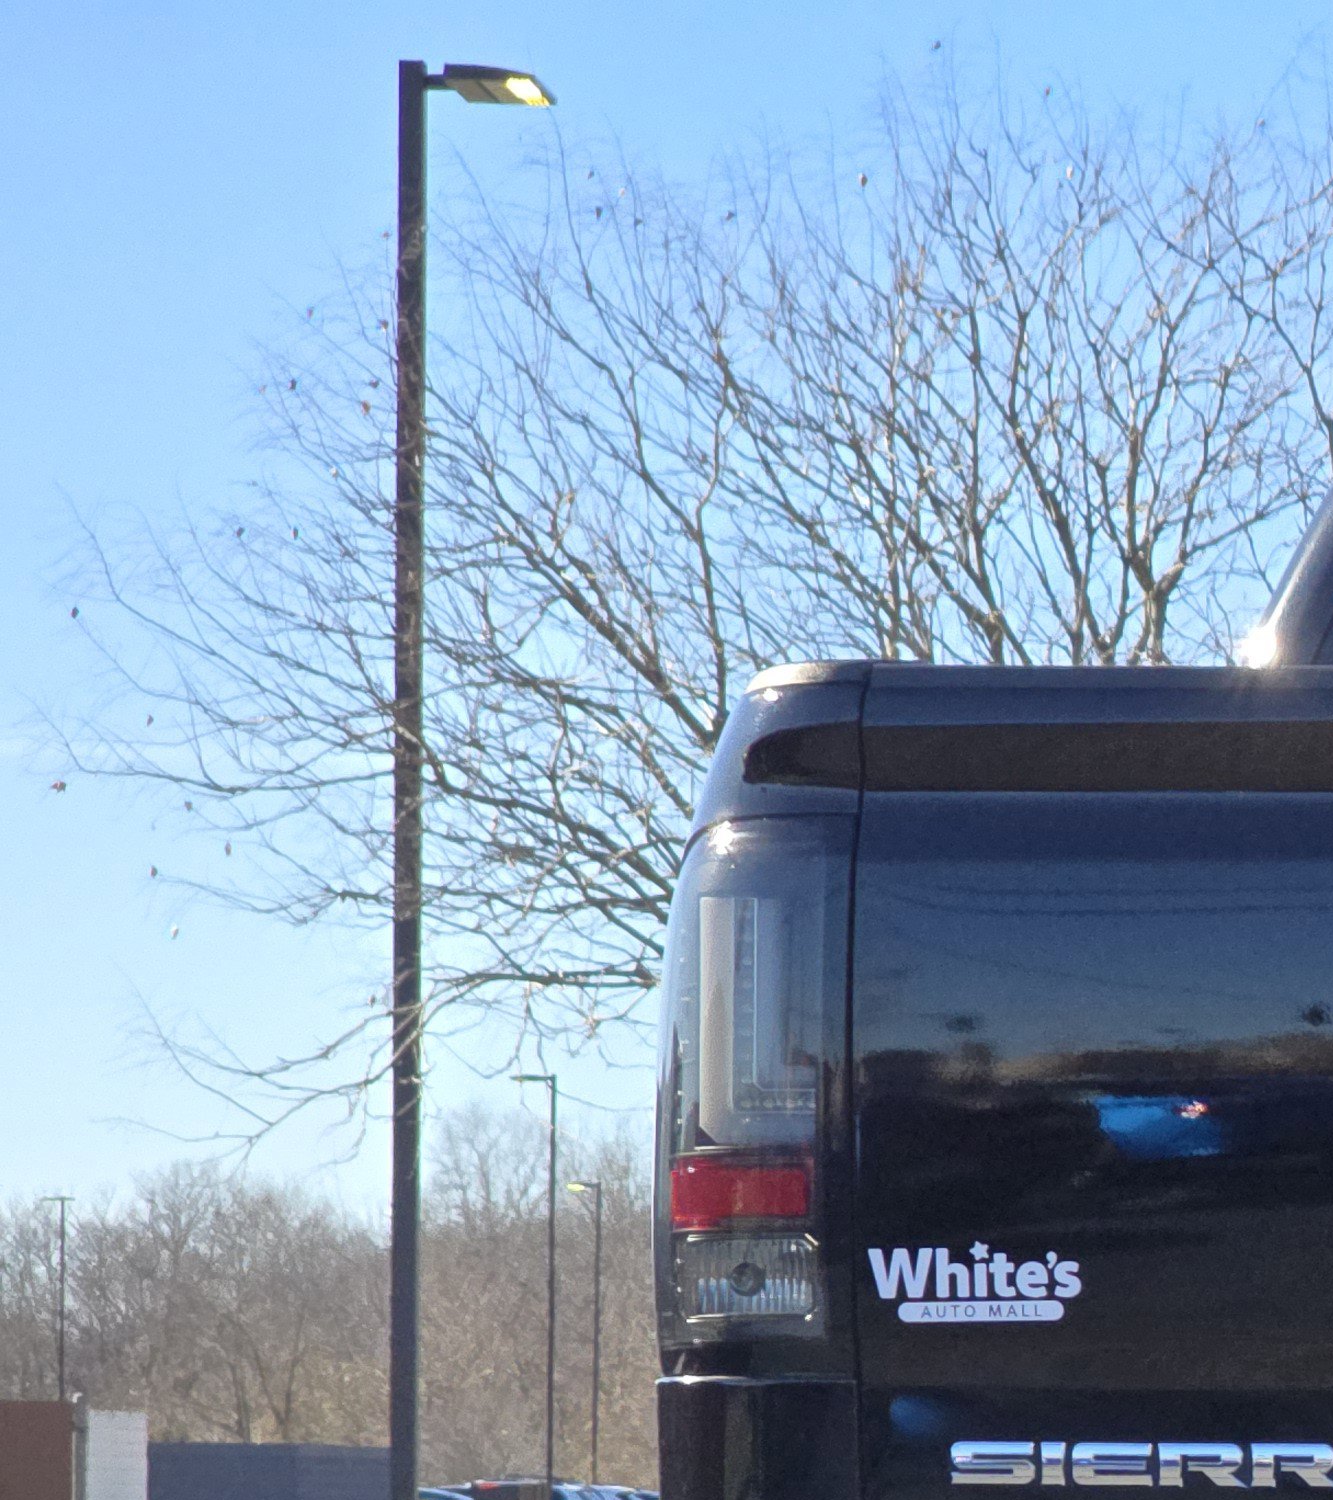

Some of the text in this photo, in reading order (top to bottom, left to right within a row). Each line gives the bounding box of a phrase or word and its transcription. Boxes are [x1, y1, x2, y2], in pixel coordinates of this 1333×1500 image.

[868, 1242, 1082, 1299] White's
[921, 1304, 1043, 1318] AUTO MALL
